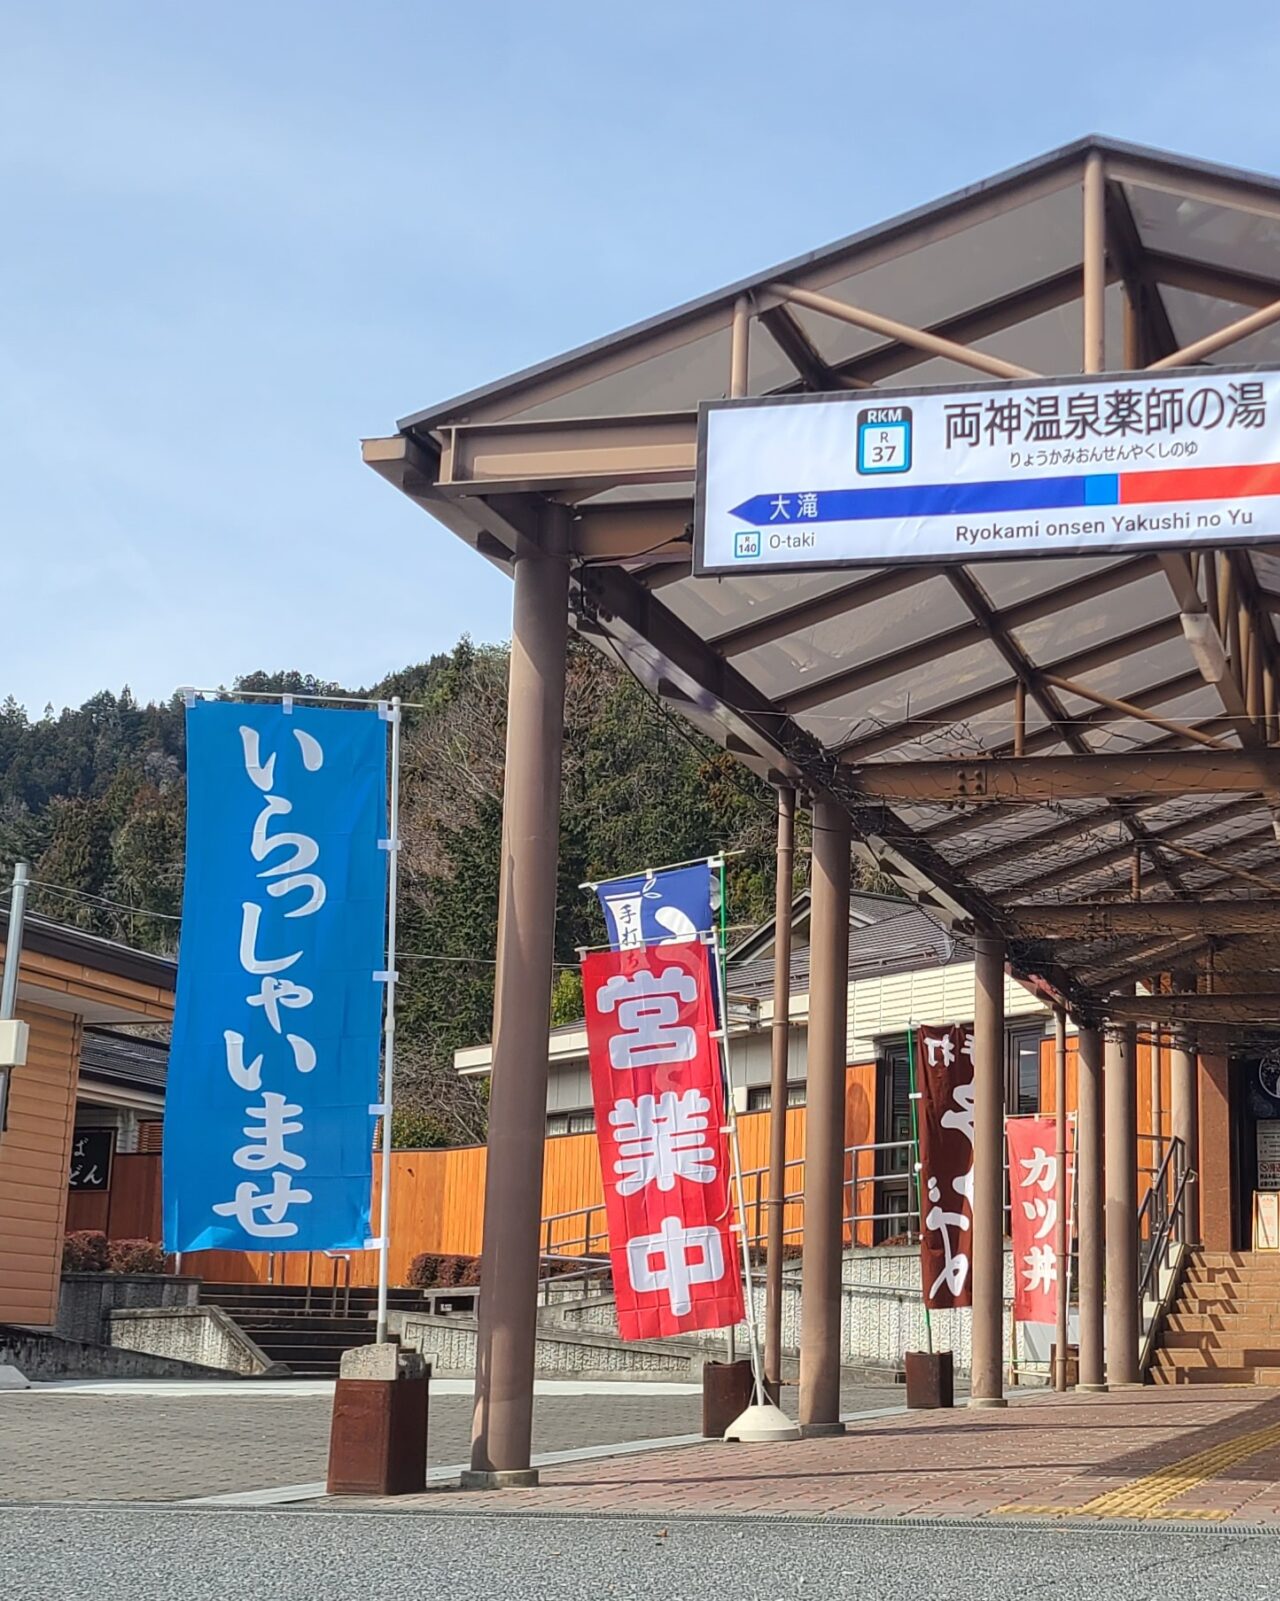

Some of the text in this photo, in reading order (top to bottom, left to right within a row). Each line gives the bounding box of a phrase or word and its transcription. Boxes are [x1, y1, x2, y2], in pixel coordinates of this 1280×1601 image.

[867, 409, 903, 424] RKM
[944, 382, 1267, 449] 両神温泉薬師の湯
[880, 431, 889, 443] R
[872, 446, 896, 463] 37
[1010, 441, 1198, 468] りょうかみおんせんやくしのゆ
[770, 493, 818, 520] 大滝
[769, 531, 815, 549] O-taki
[956, 509, 1253, 545] Ryokami onsen Yakushi no Yu
[738, 543, 757, 553] 140
[213, 724, 327, 1239] いらっしゃいませ
[596, 966, 726, 1318] 営業中
